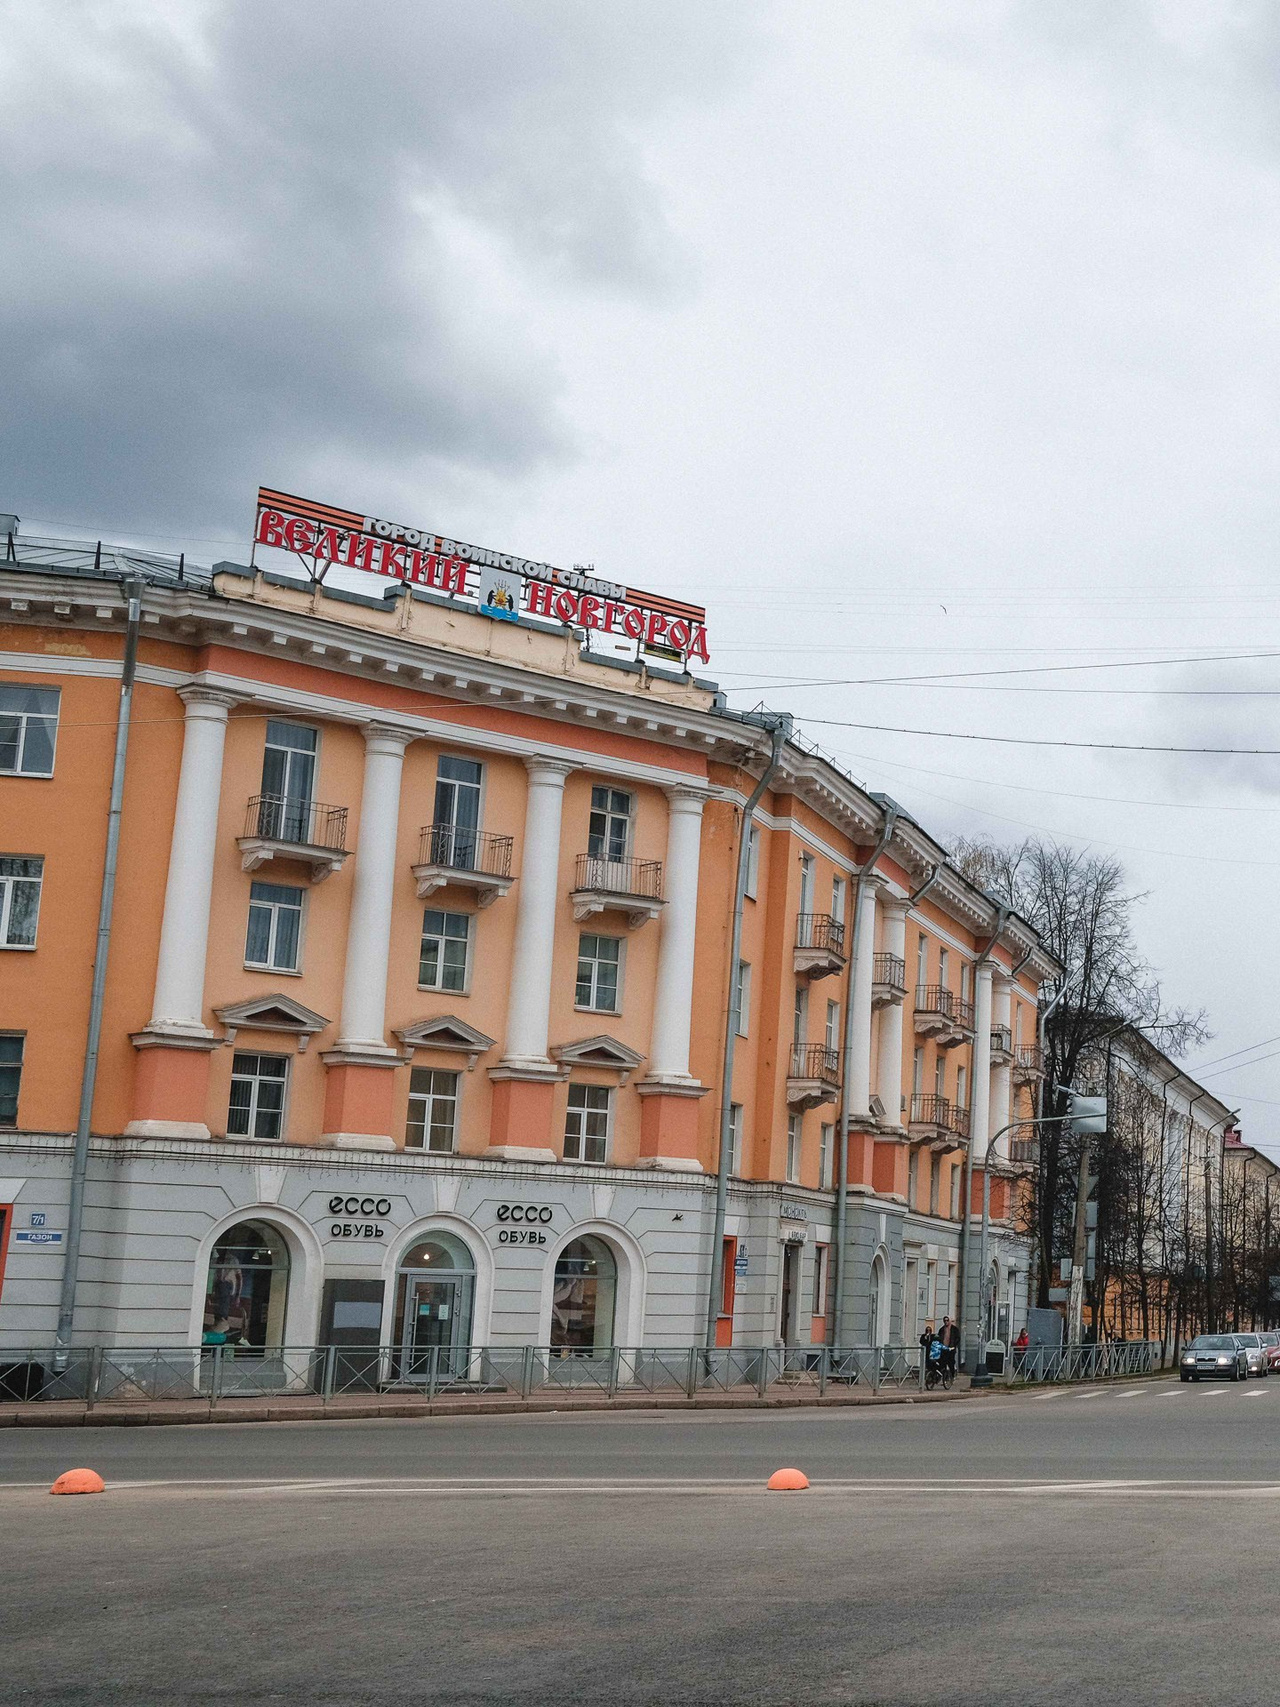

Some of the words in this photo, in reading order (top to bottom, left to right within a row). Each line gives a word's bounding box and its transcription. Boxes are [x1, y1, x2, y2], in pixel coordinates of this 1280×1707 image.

[363, 516, 436, 553] ГОРОД
[441, 538, 553, 582] ВОИНСКОЙ
[557, 571, 626, 601] СЛАВЫ
[255, 508, 470, 595] ВЕЛИКИЙ
[526, 580, 710, 665] НОВГОРОД
[32, 1214, 44, 1225] 7/1
[330, 1223, 384, 1238] ОБУВЬ
[499, 1230, 547, 1244] ОБУВЬ
